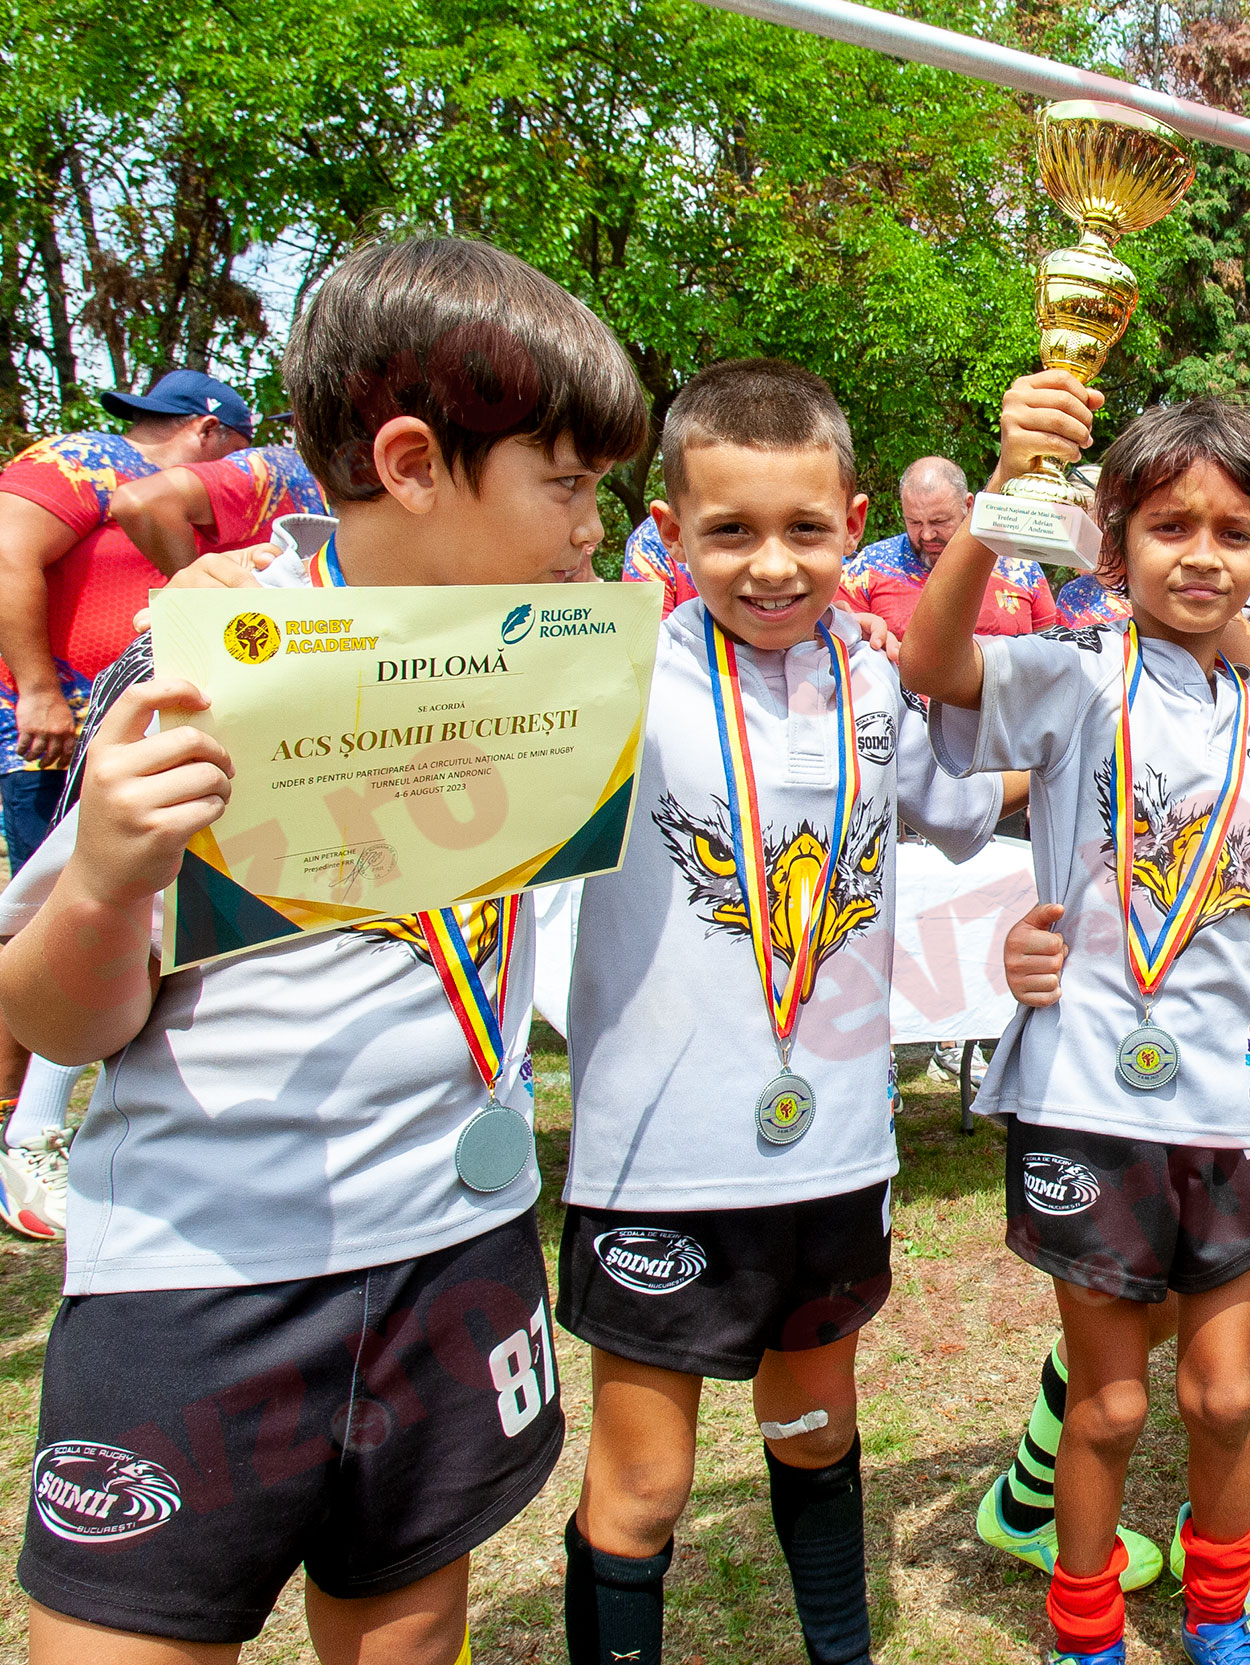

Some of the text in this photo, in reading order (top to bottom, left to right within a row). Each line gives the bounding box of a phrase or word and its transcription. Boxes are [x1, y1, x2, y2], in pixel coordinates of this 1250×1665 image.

[541, 608, 592, 623] RUGBY
[285, 618, 354, 635] RUGBY
[539, 621, 617, 638] ROMANIA
[285, 636, 379, 654] ACADEMY
[376, 648, 509, 682] DIPLOMĂ
[417, 701, 466, 713] SE ACORDĂ
[270, 735, 332, 761] ACS
[272, 778, 306, 790] UNDER
[308, 777, 314, 785] 8
[316, 772, 354, 784] PENTRU
[356, 764, 416, 779] PARTICIPAREA
[418, 762, 428, 771] LA
[430, 757, 473, 769] CIRCUITUL
[517, 751, 528, 760] DE
[530, 749, 550, 758] MINI
[549, 745, 575, 755] RUGBY
[371, 767, 492, 789] TURNEUL ADRIAN ANDRONIC
[395, 782, 467, 799] 4-6 AUGUST 2023
[303, 848, 357, 864] ALIN PETRACHE
[84, 1447, 97, 1455] DE
[98, 1448, 135, 1463] RUGBY
